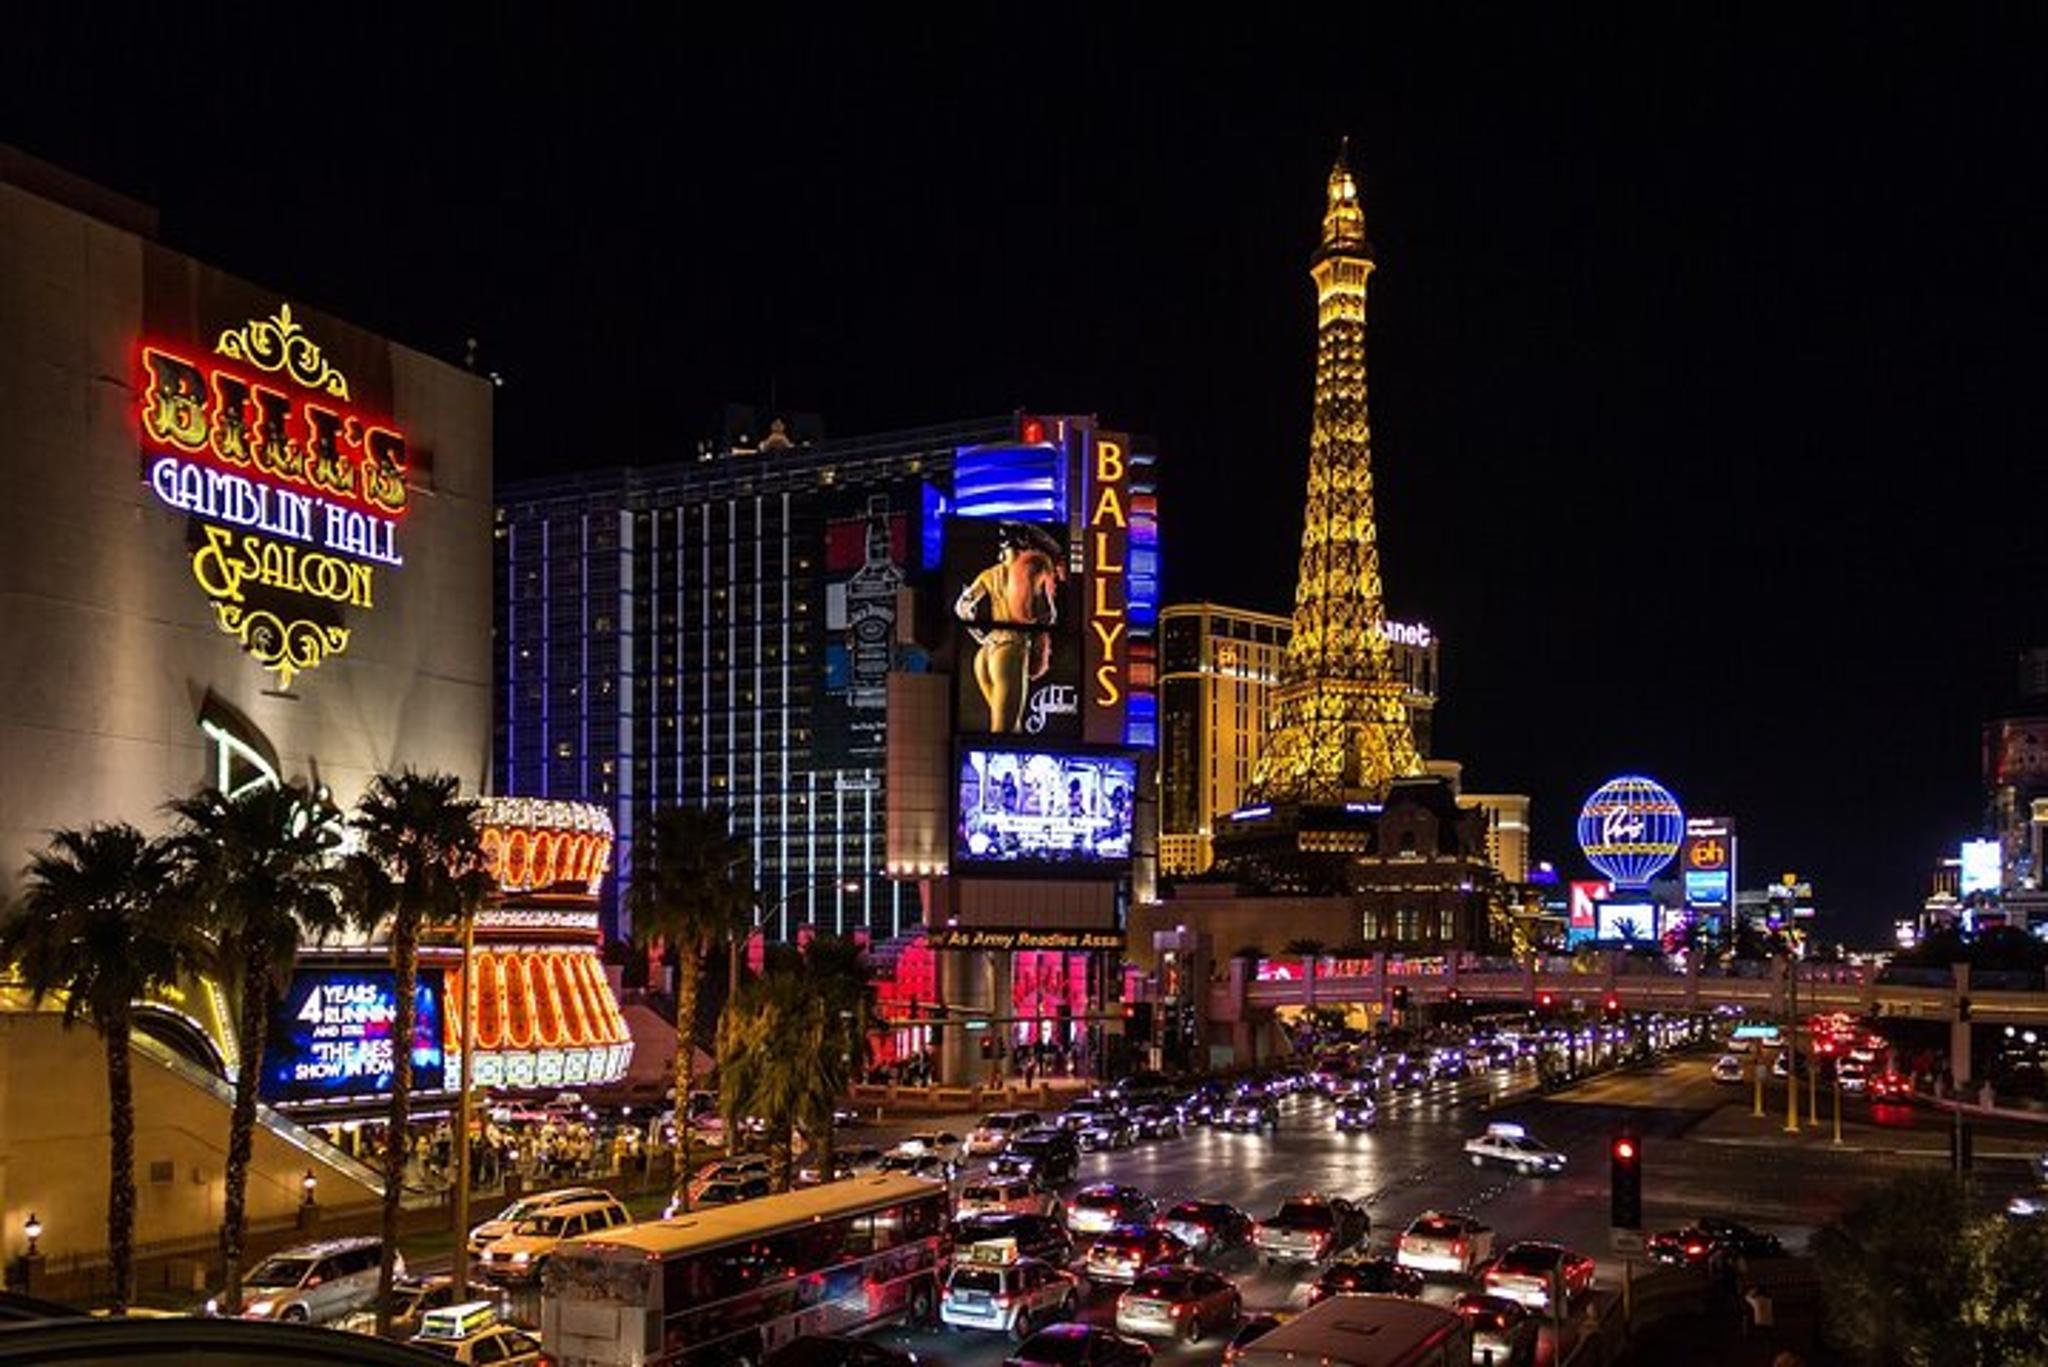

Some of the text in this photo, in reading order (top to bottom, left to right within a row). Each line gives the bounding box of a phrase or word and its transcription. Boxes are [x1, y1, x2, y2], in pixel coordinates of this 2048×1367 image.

[142, 347, 407, 513] BILL'S
[152, 457, 402, 565] GAMBLIN' HALL
[193, 525, 374, 608] & SALOON
[1091, 441, 1127, 706] BALLYS
[949, 931, 969, 946] As
[973, 932, 1014, 949] Army
[297, 985, 377, 1024] 4 YEARS
[324, 1005, 396, 1023] RUNNIN
